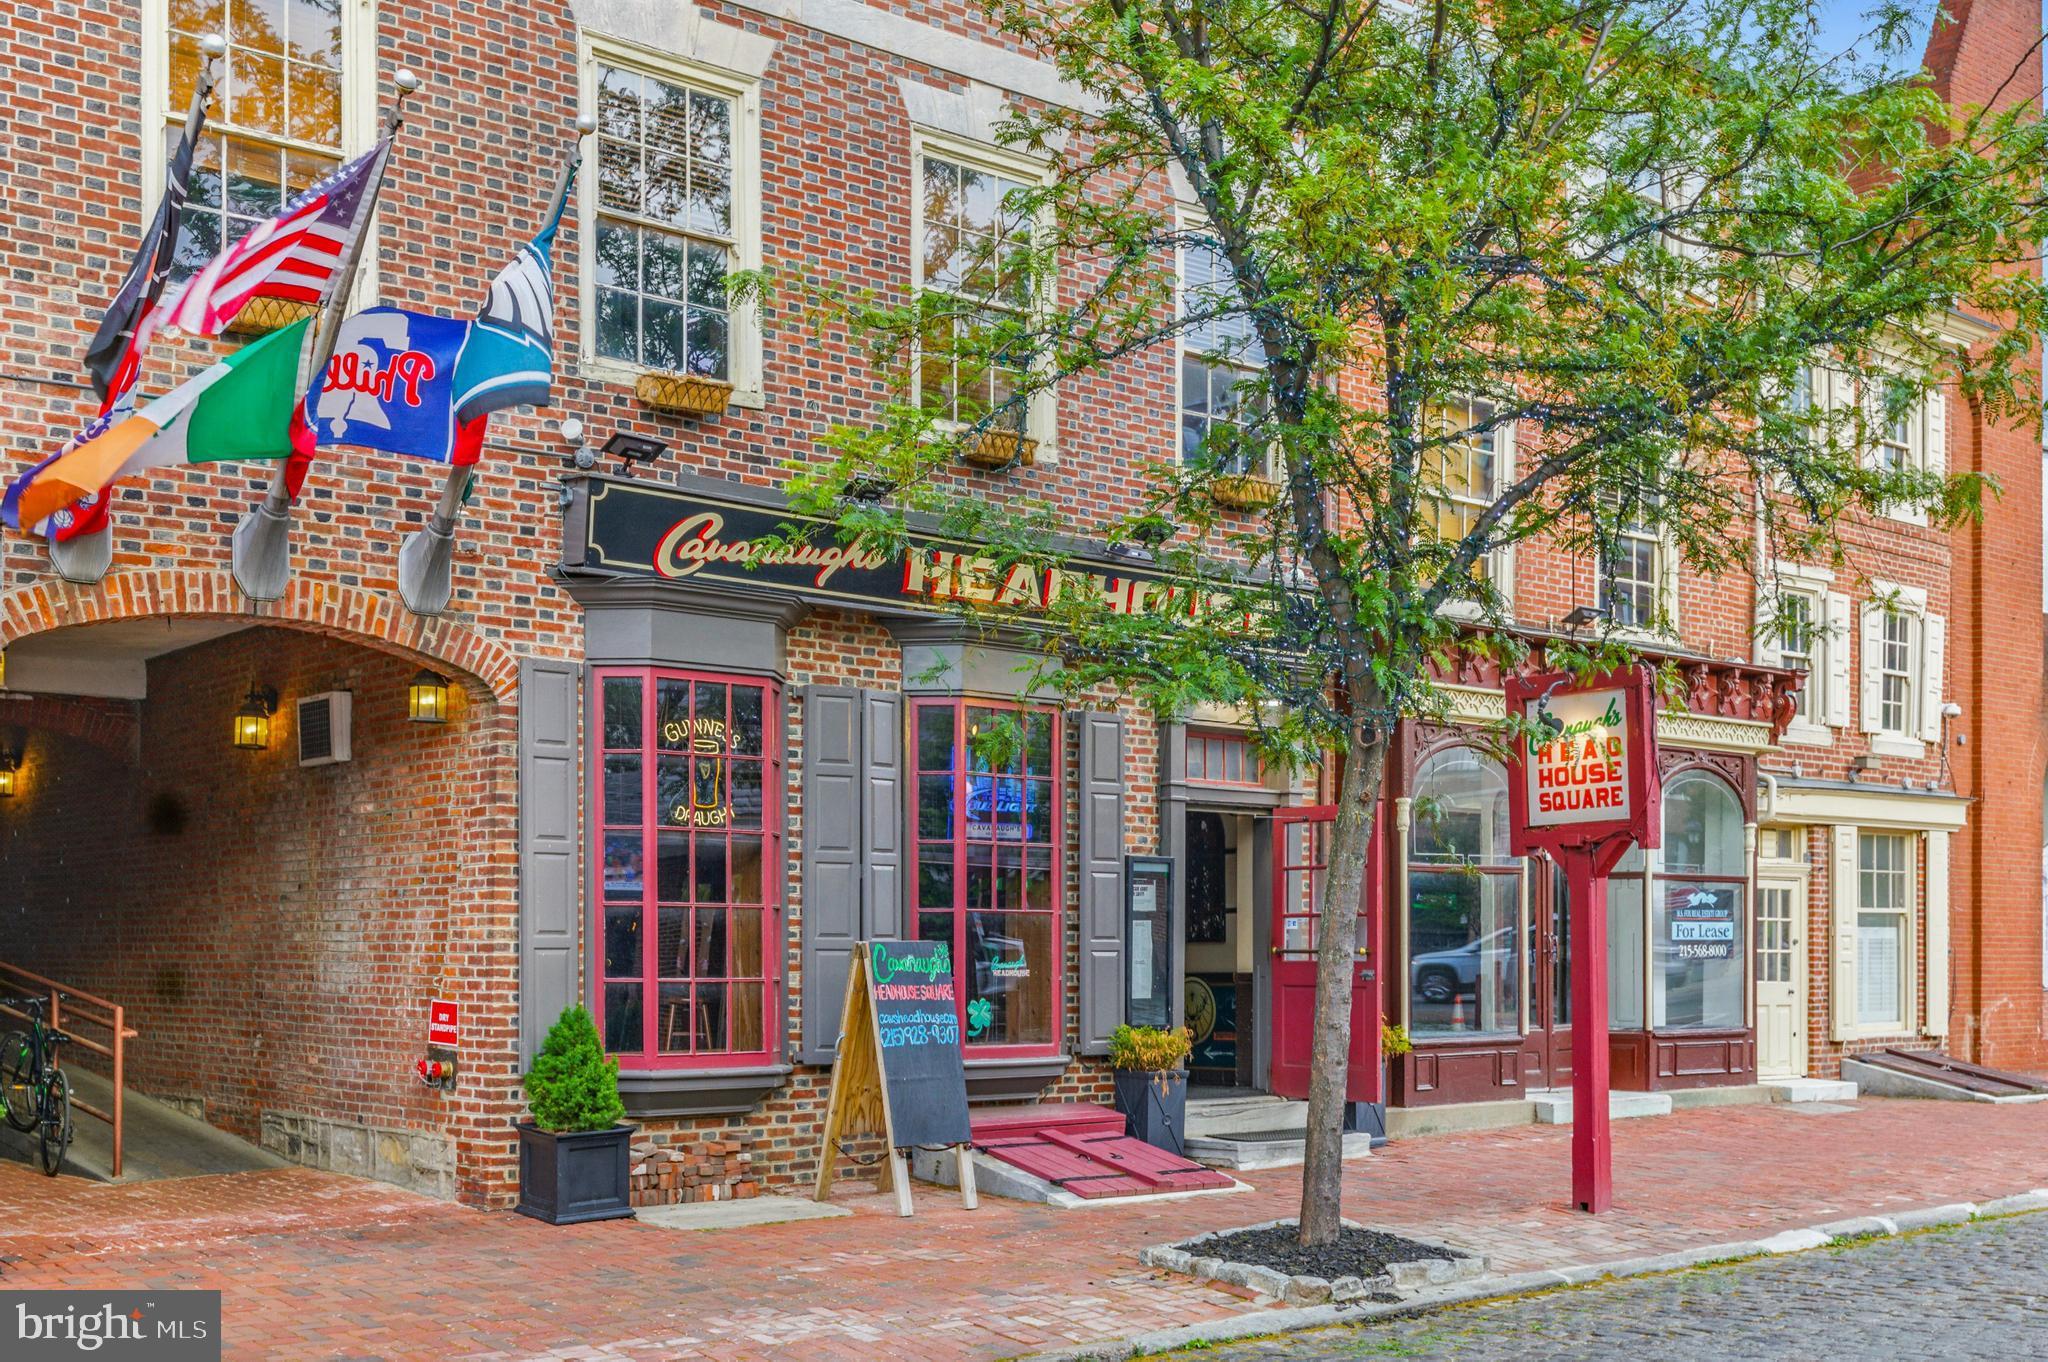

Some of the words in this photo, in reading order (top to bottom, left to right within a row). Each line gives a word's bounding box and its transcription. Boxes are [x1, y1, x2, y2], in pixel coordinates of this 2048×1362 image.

[665, 719, 741, 749] GUNNES
[1538, 736, 1623, 764] HEAD
[1538, 761, 1622, 788] HOUSE
[1539, 786, 1624, 812] SQUARE
[972, 824, 1021, 832] CAVAAUGH'S
[1676, 924, 1695, 938] For
[1698, 924, 1730, 938] Lease
[1679, 944, 1727, 957] 215-568-8000
[874, 984, 920, 1000] HEADHOUSE
[921, 984, 955, 1000] SQUARE
[431, 1023, 457, 1033] STANDPIPE
